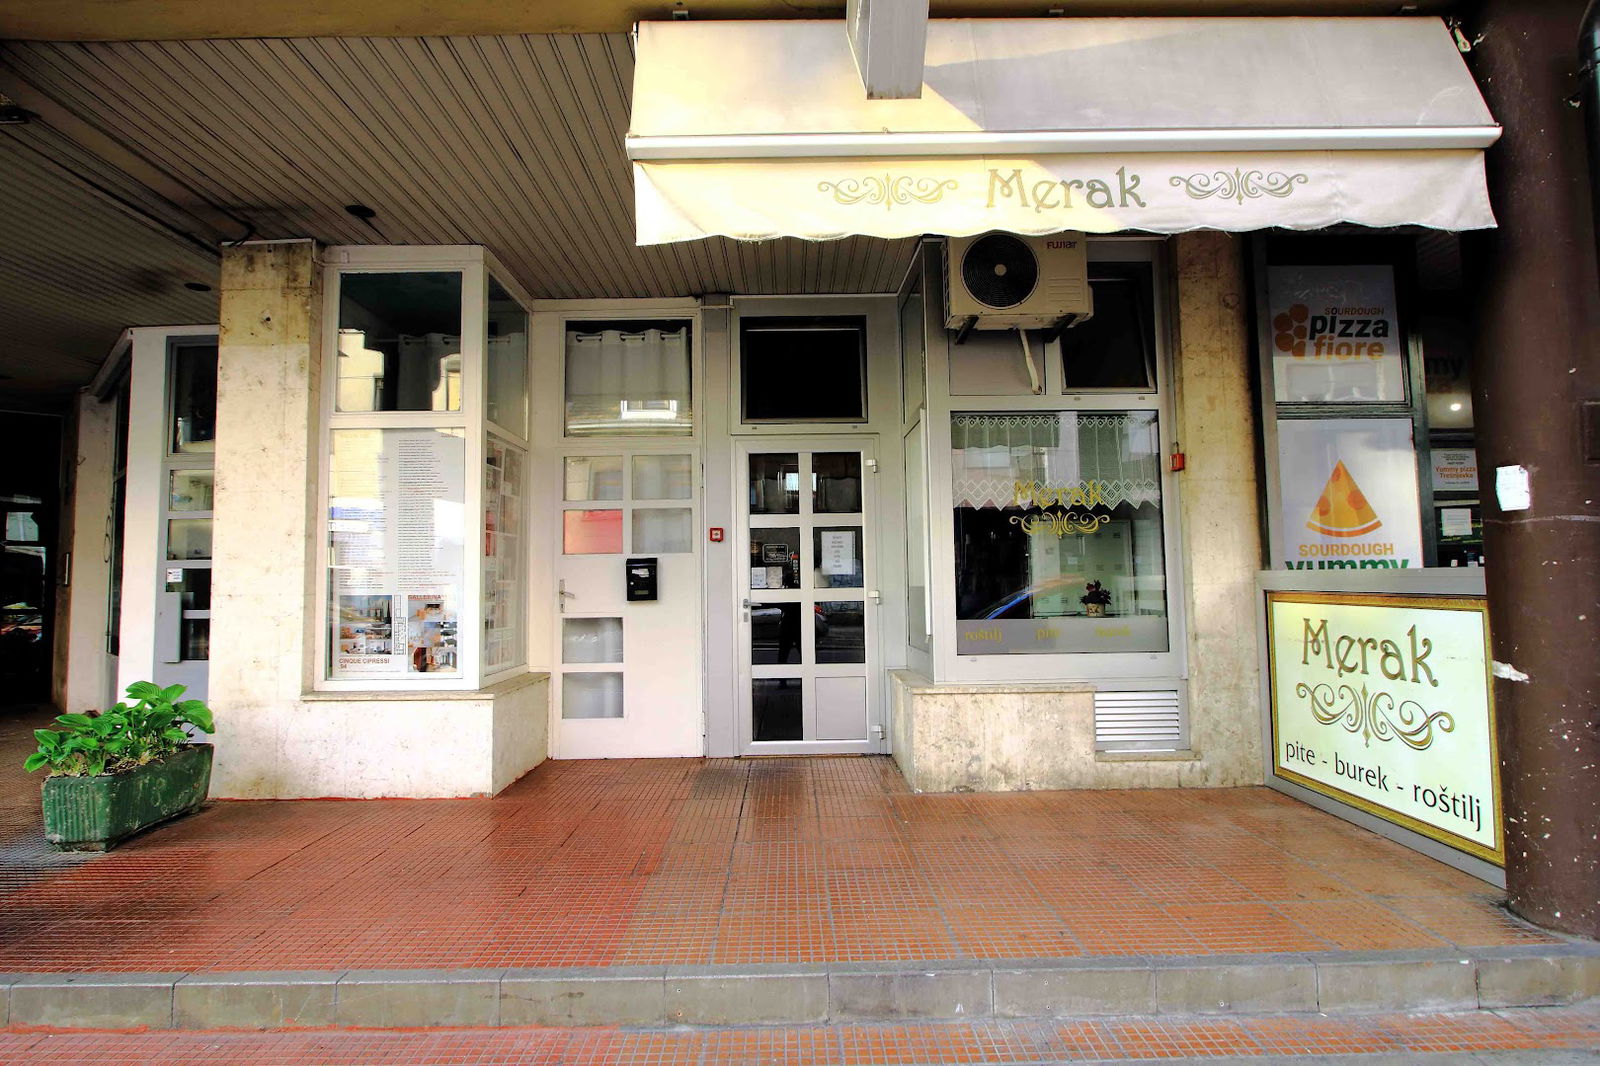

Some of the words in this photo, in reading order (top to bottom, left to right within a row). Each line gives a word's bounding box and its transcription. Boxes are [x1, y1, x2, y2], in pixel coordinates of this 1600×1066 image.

[986, 166, 1147, 213] Merak
[1325, 307, 1384, 316] SOURDOUGH
[1309, 315, 1389, 340] pizza
[1313, 335, 1385, 360] fiore
[1014, 480, 1105, 506] Merak
[1298, 543, 1394, 557] SOURDOUGH
[1302, 618, 1439, 687] Merak
[1286, 741, 1315, 765] pite
[1335, 752, 1389, 792] burek
[1413, 784, 1482, 832] roštilj
